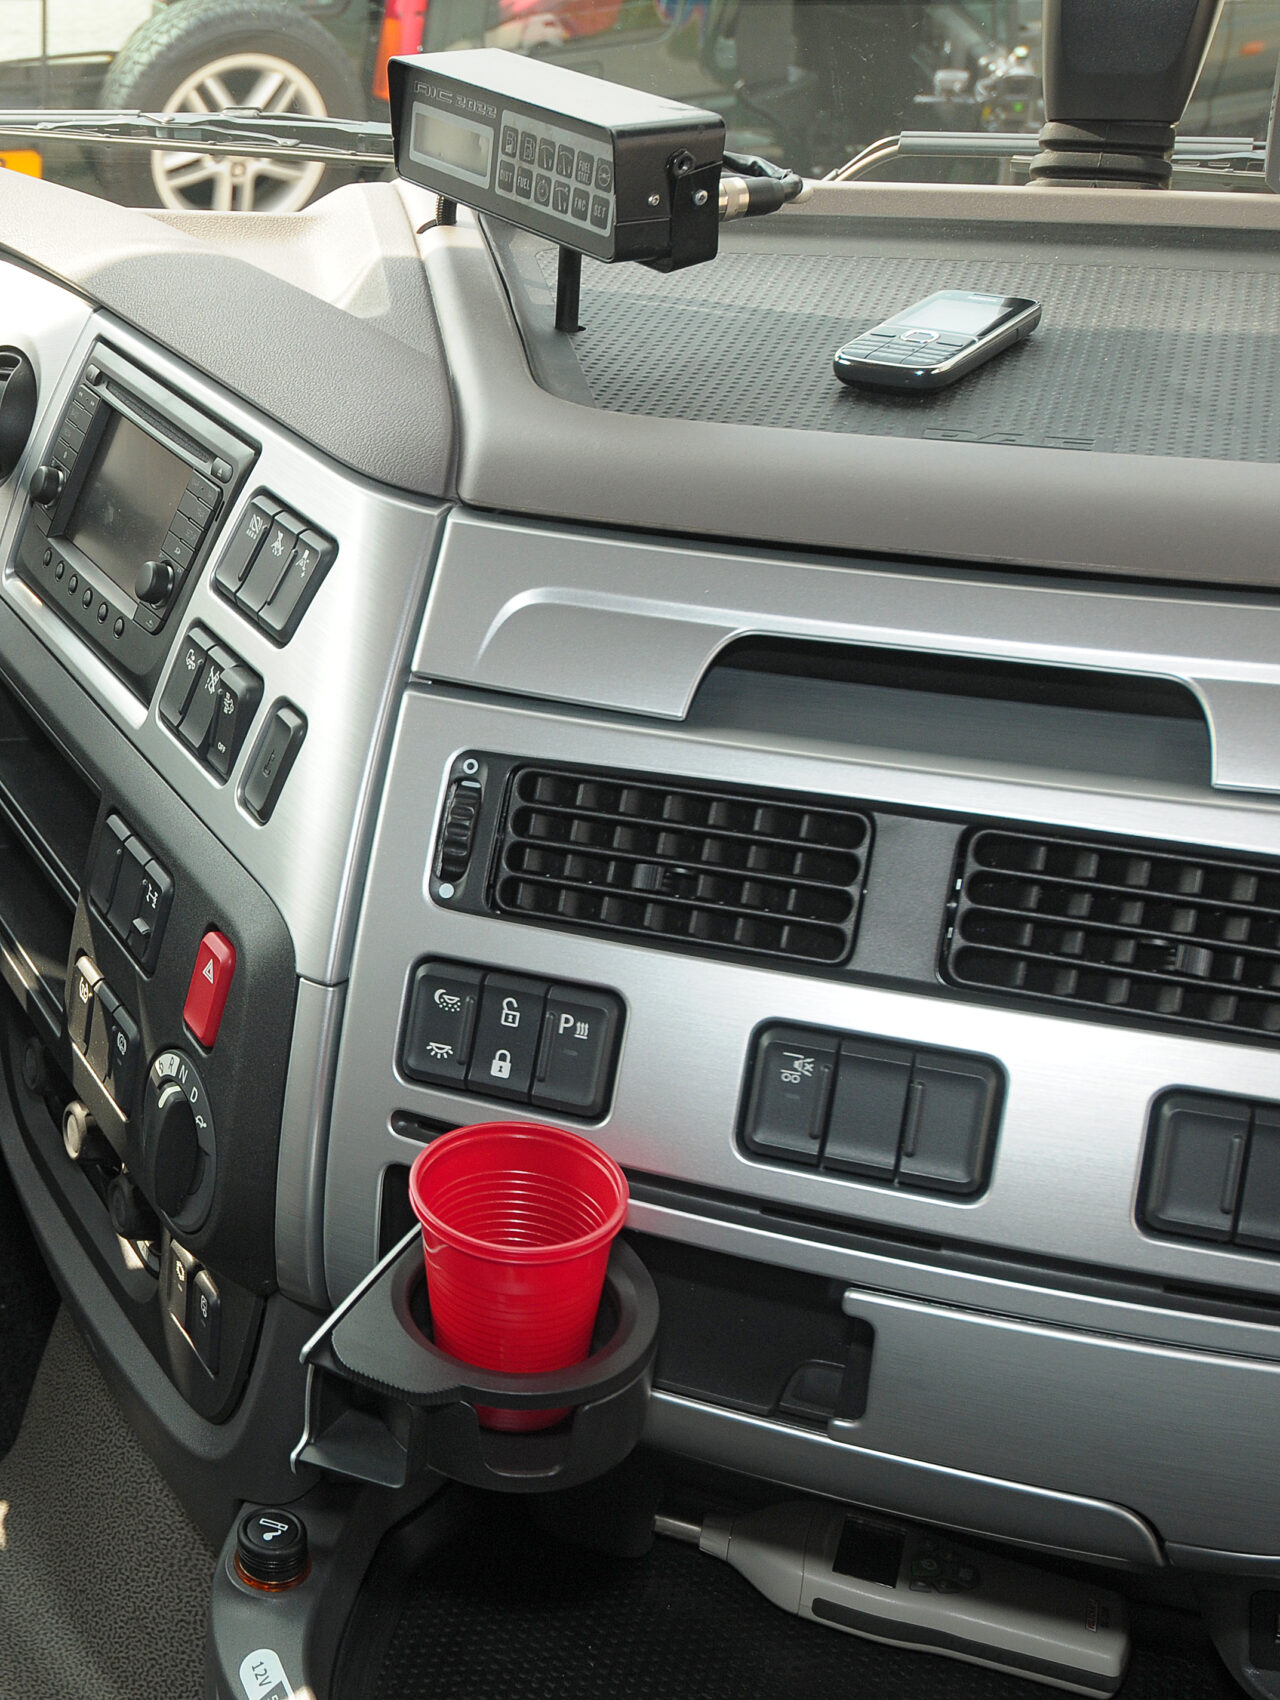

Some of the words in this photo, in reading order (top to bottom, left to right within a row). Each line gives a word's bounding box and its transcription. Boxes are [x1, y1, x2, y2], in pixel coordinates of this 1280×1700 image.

[456, 94, 497, 119] 2022
[517, 176, 530, 191] FUEL
[593, 204, 607, 219] SET
[558, 1013, 575, 1035] P
[179, 1064, 188, 1084] N
[189, 1086, 198, 1103] D
[251, 1661, 272, 1687] 12V
